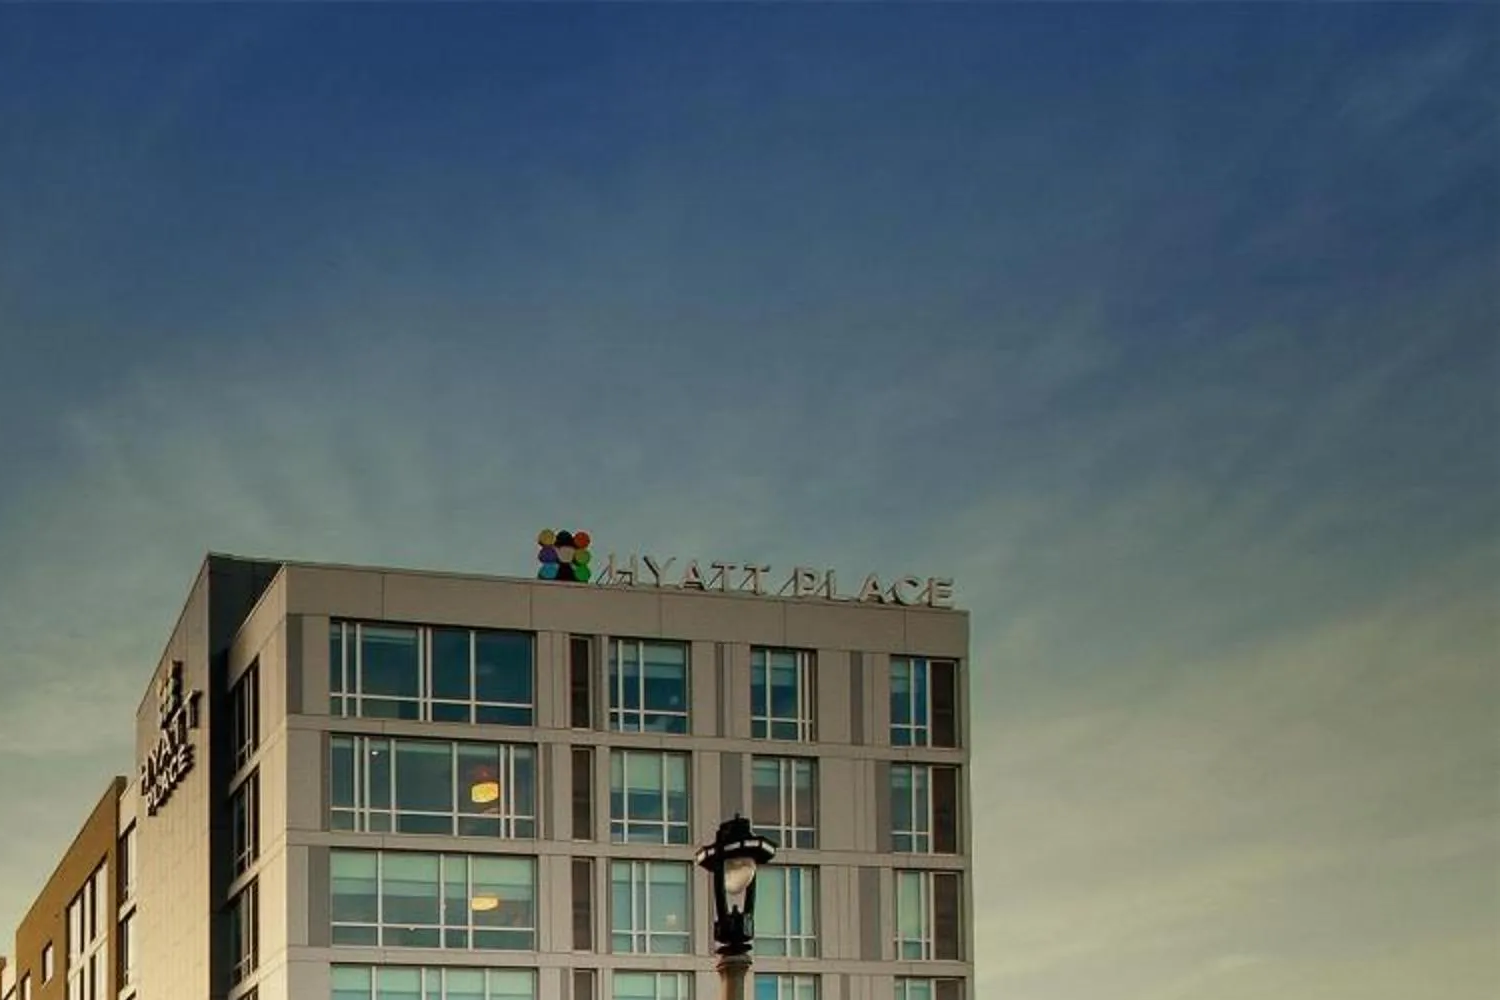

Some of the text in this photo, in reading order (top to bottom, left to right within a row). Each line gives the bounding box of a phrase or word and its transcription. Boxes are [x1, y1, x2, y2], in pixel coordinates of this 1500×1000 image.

[605, 552, 956, 609] HYATT PLACE
[147, 743, 196, 816] PLACE
